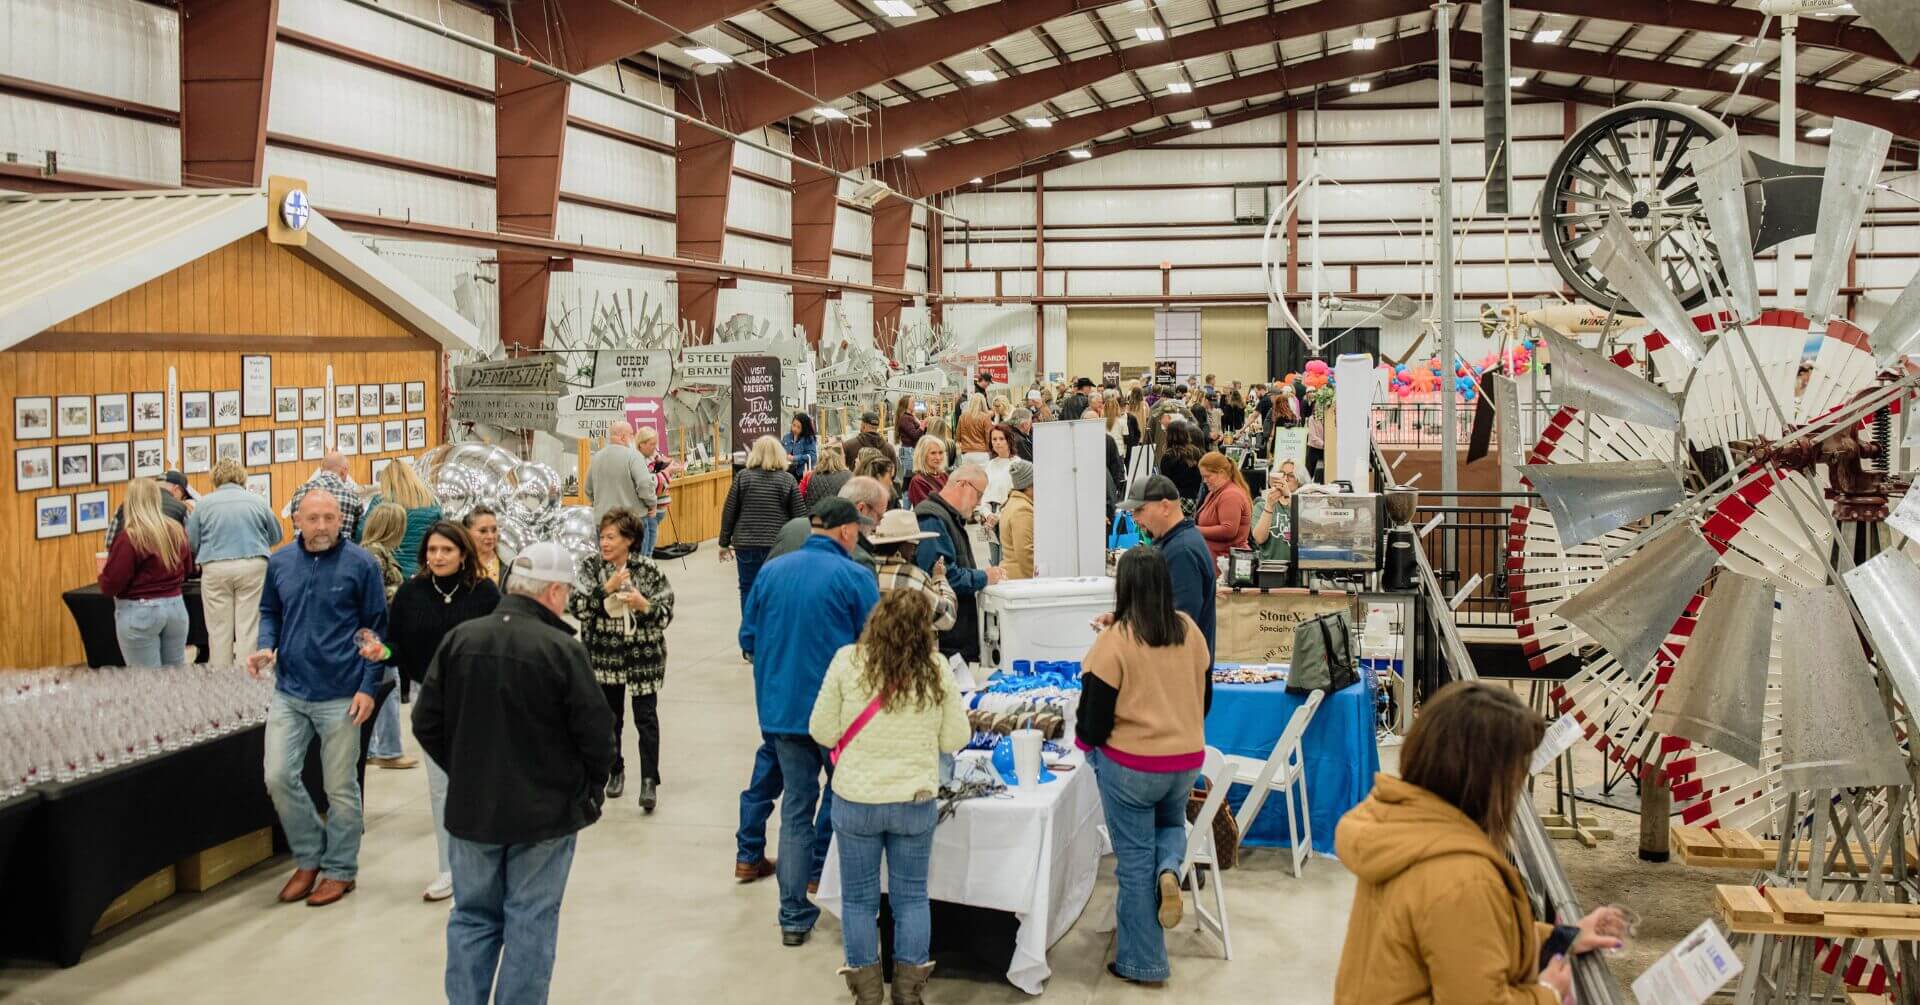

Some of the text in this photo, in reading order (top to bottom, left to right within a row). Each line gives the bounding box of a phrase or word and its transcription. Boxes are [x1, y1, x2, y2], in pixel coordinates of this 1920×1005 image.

[616, 355, 649, 366] QUEEN
[687, 354, 728, 363] STEEL
[467, 361, 554, 388] DEMPSTER
[621, 367, 645, 378] CITY
[750, 366, 766, 375] VISIT
[744, 375, 773, 384] LUBBOCK
[743, 384, 774, 393] PRESENTS
[575, 394, 625, 411] DEMPSTER
[1259, 624, 1291, 634] Specialty
